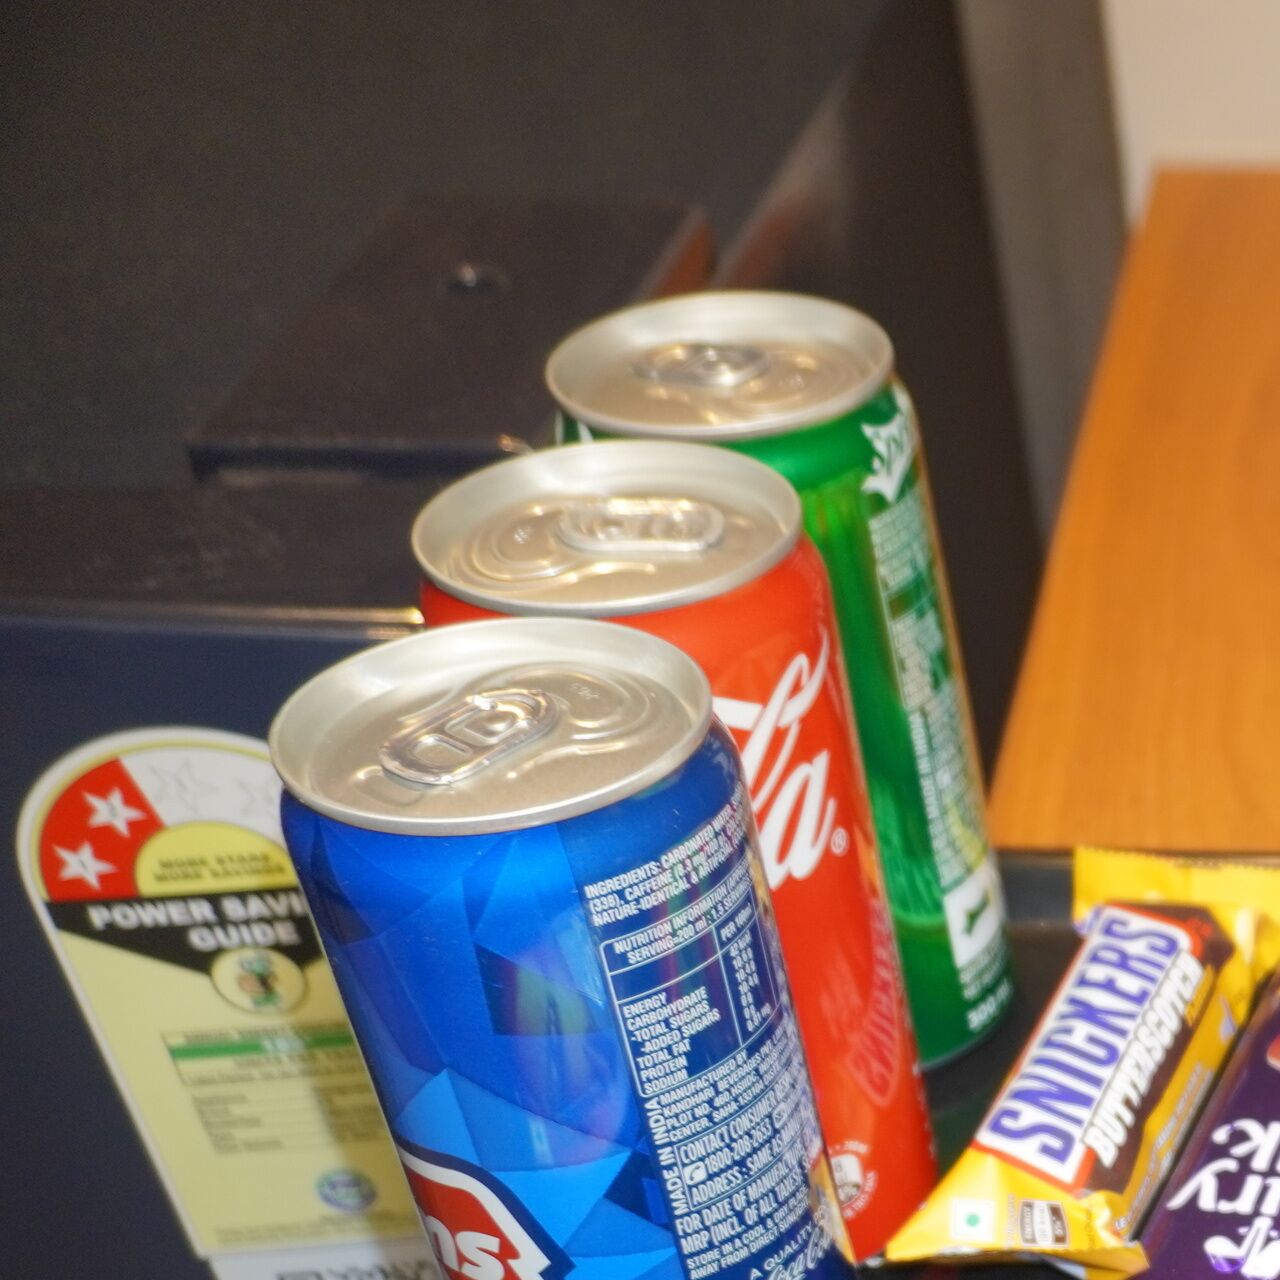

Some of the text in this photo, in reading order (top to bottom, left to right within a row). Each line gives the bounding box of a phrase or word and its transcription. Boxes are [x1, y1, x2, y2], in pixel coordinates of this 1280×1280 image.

[87, 897, 218, 931] POWER
[187, 919, 300, 952] GUIDE
[623, 991, 667, 1018] ENERGY
[636, 1039, 692, 1069] TOTAL FAT
[986, 915, 1180, 1165] SNICKERS
[640, 1055, 688, 1082] PROTEIN
[1084, 952, 1204, 1169] BUTTERSCOTCH
[644, 1097, 690, 1216] MADE IN INDIA
[675, 1211, 703, 1238] FOR
[680, 1231, 712, 1255] MRP
[686, 1248, 721, 1270] STORE
